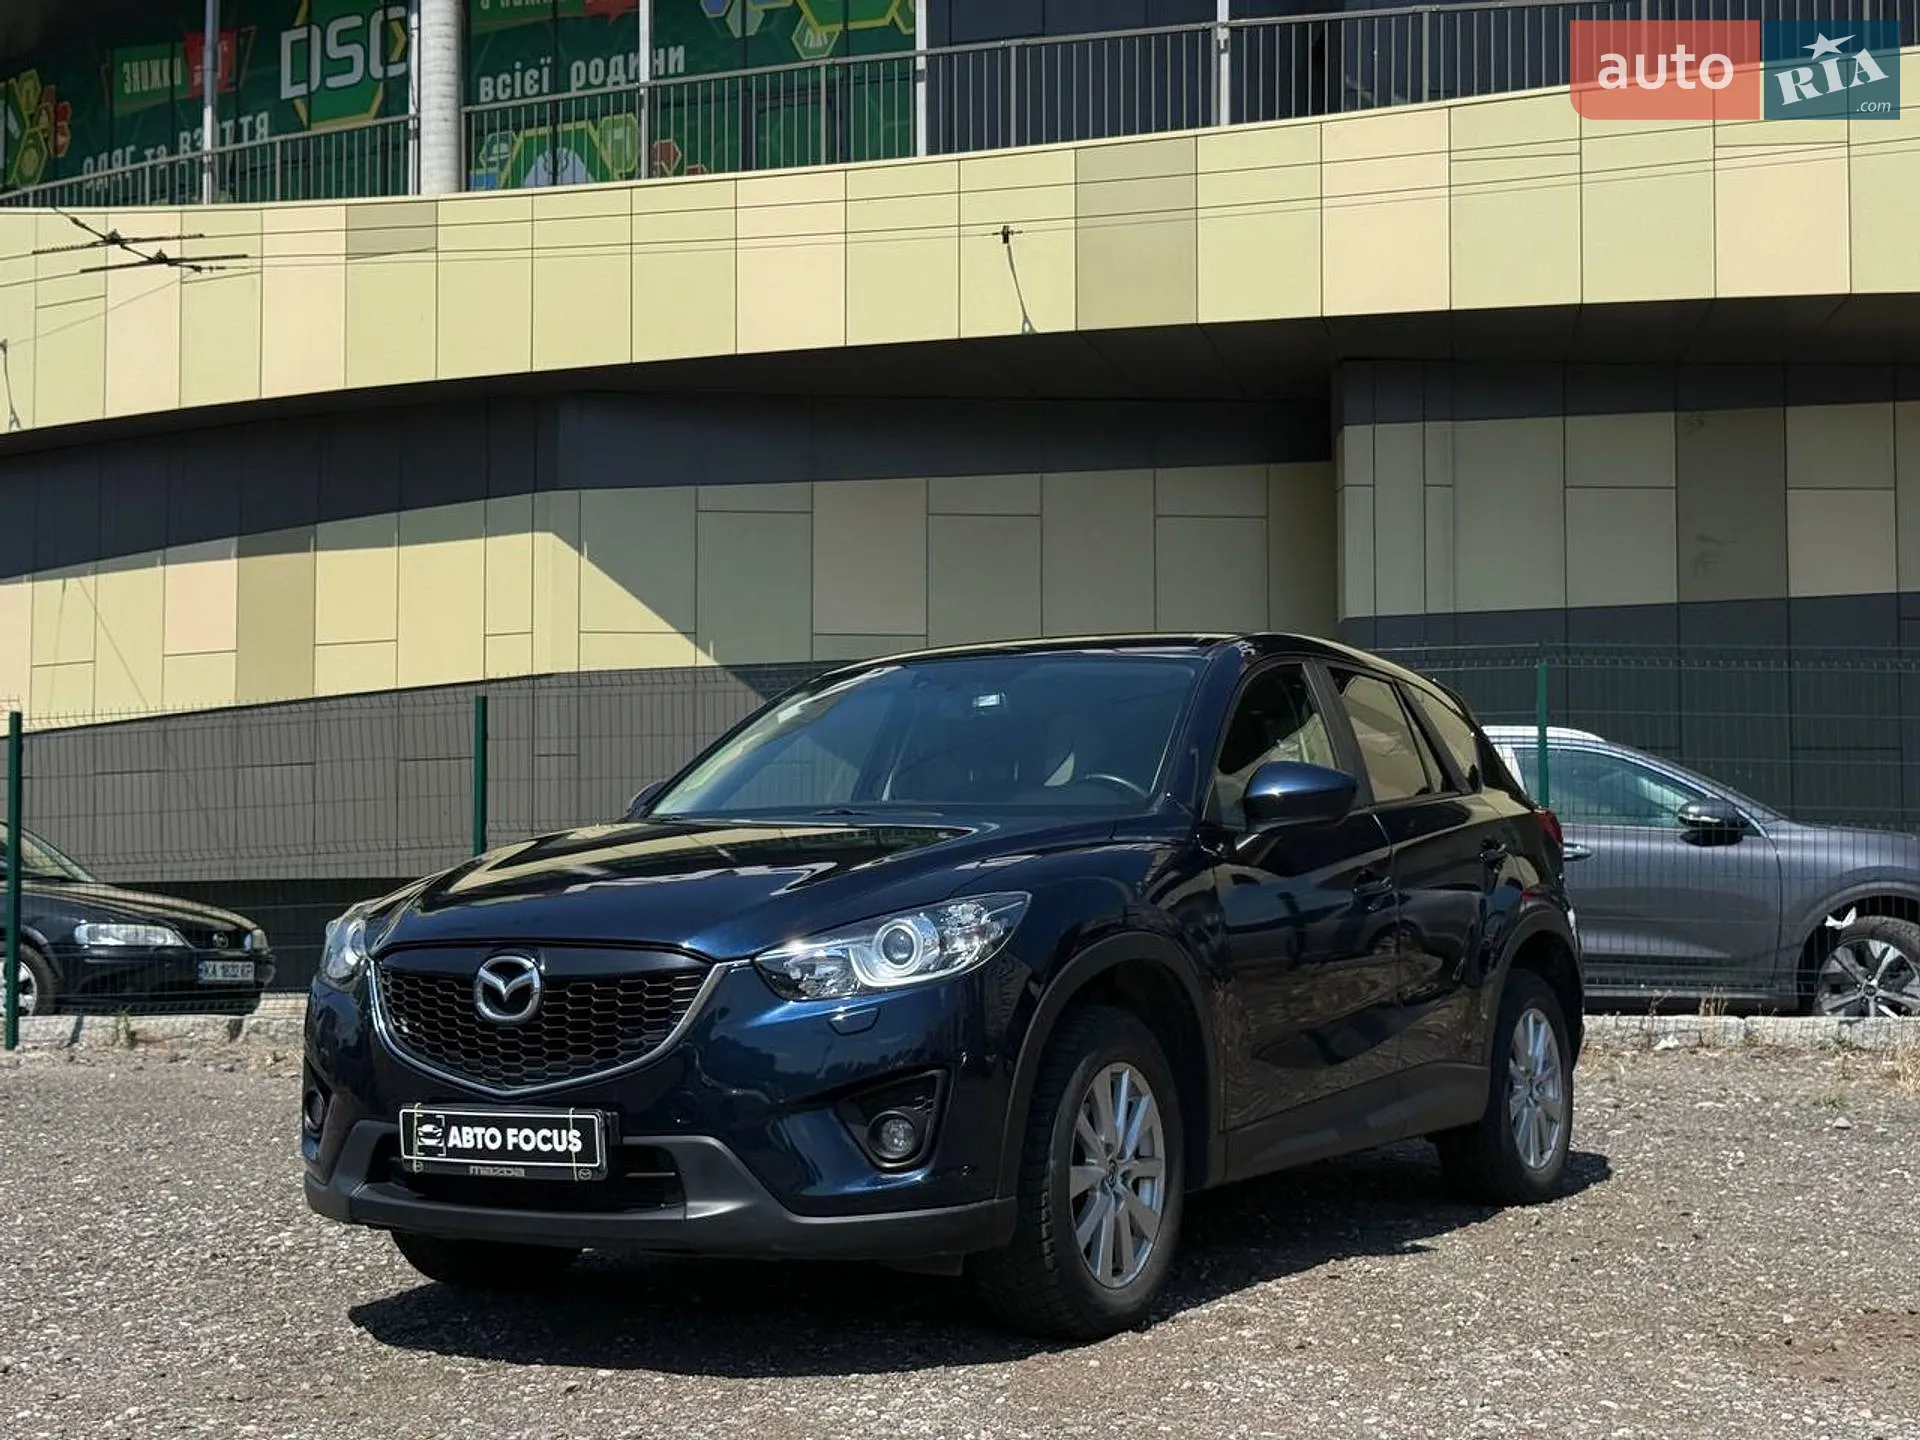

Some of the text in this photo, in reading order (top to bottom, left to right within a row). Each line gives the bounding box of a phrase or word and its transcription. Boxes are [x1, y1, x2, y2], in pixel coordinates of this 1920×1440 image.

[478, 45, 686, 103] всієї родини
[178, 111, 270, 164] ВЗТТЯ
[506, 1128, 582, 1152] FOCUS
